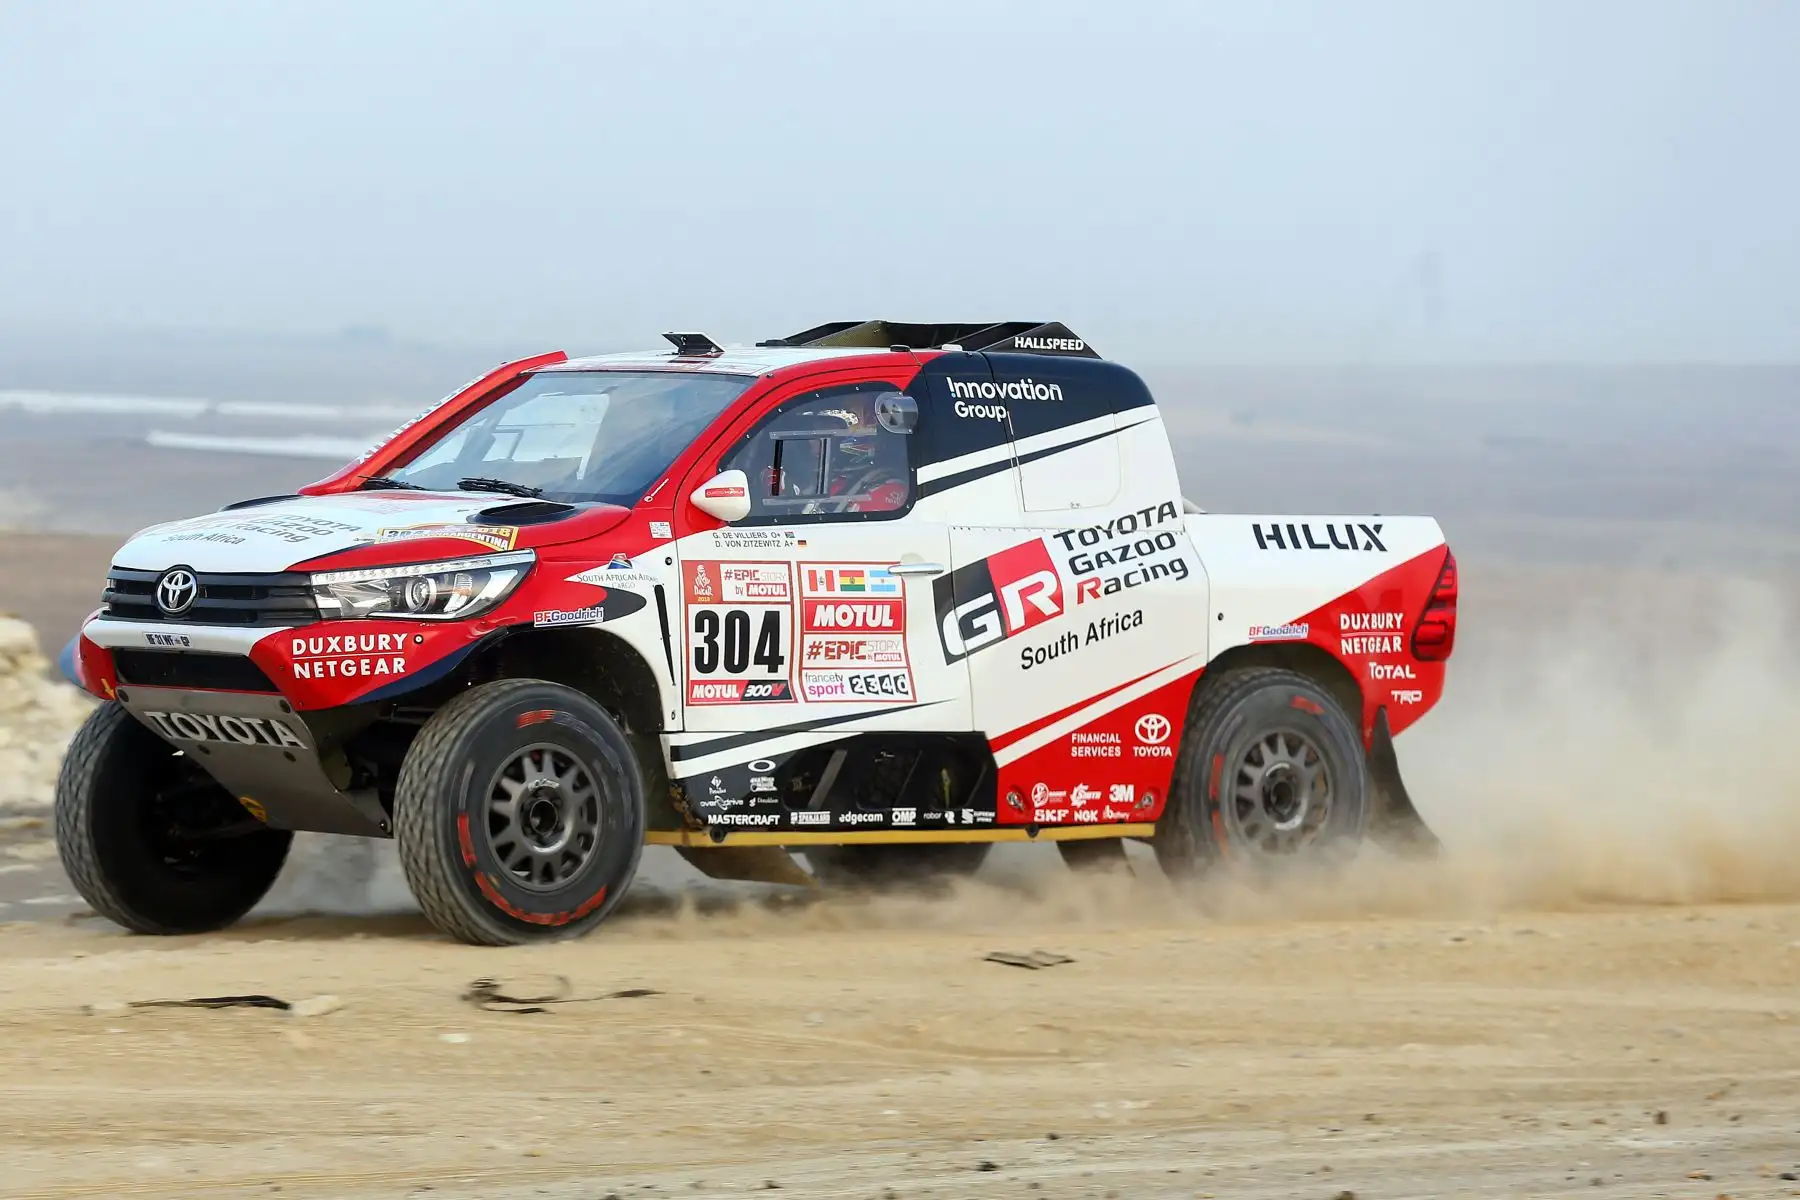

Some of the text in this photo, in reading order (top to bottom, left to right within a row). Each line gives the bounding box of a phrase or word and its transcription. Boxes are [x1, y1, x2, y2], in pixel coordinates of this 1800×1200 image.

[1015, 337, 1084, 351] HALLSPEED
[954, 402, 1006, 423] Group
[252, 518, 334, 536] GAZOO
[275, 514, 362, 532] TOYOTA
[1053, 501, 1178, 551] TOYOTA
[204, 532, 246, 545] Africa
[234, 523, 311, 543] Racing
[1252, 523, 1388, 552] HILUX
[1068, 532, 1178, 576] GAZOO
[605, 573, 637, 581] AFRICAN
[1076, 557, 1189, 605] Racing
[735, 584, 786, 596] by MOTUL
[535, 608, 603, 623] BFGoodrich
[813, 604, 894, 627] MOTUL
[942, 570, 1061, 657] GR
[1340, 613, 1404, 630] DUXBURY
[1248, 622, 1308, 636] BFGoodrich
[292, 633, 408, 655] DUXBURY
[694, 610, 784, 674] 304
[1021, 609, 1143, 671] South Africa
[1341, 636, 1402, 655] NETGEAR
[875, 653, 902, 661] MOTUL
[293, 657, 406, 679] NETGEAR
[1369, 662, 1416, 679] TOTAL
[805, 672, 843, 683] francetv
[692, 683, 785, 699] MOTUL 300V
[808, 682, 845, 697] sport
[1391, 690, 1422, 704] TRD
[144, 711, 308, 750] TOYOTA
[1071, 733, 1121, 744] FINANCIAL
[1071, 745, 1121, 757] SERVICES
[1133, 746, 1172, 757] TOYOTA
[1109, 784, 1134, 802] 3M
[708, 814, 780, 826] MASTERCRAFT
[892, 810, 917, 823] OMP
[1034, 809, 1069, 822] SKF
[1074, 810, 1098, 822] NGK
